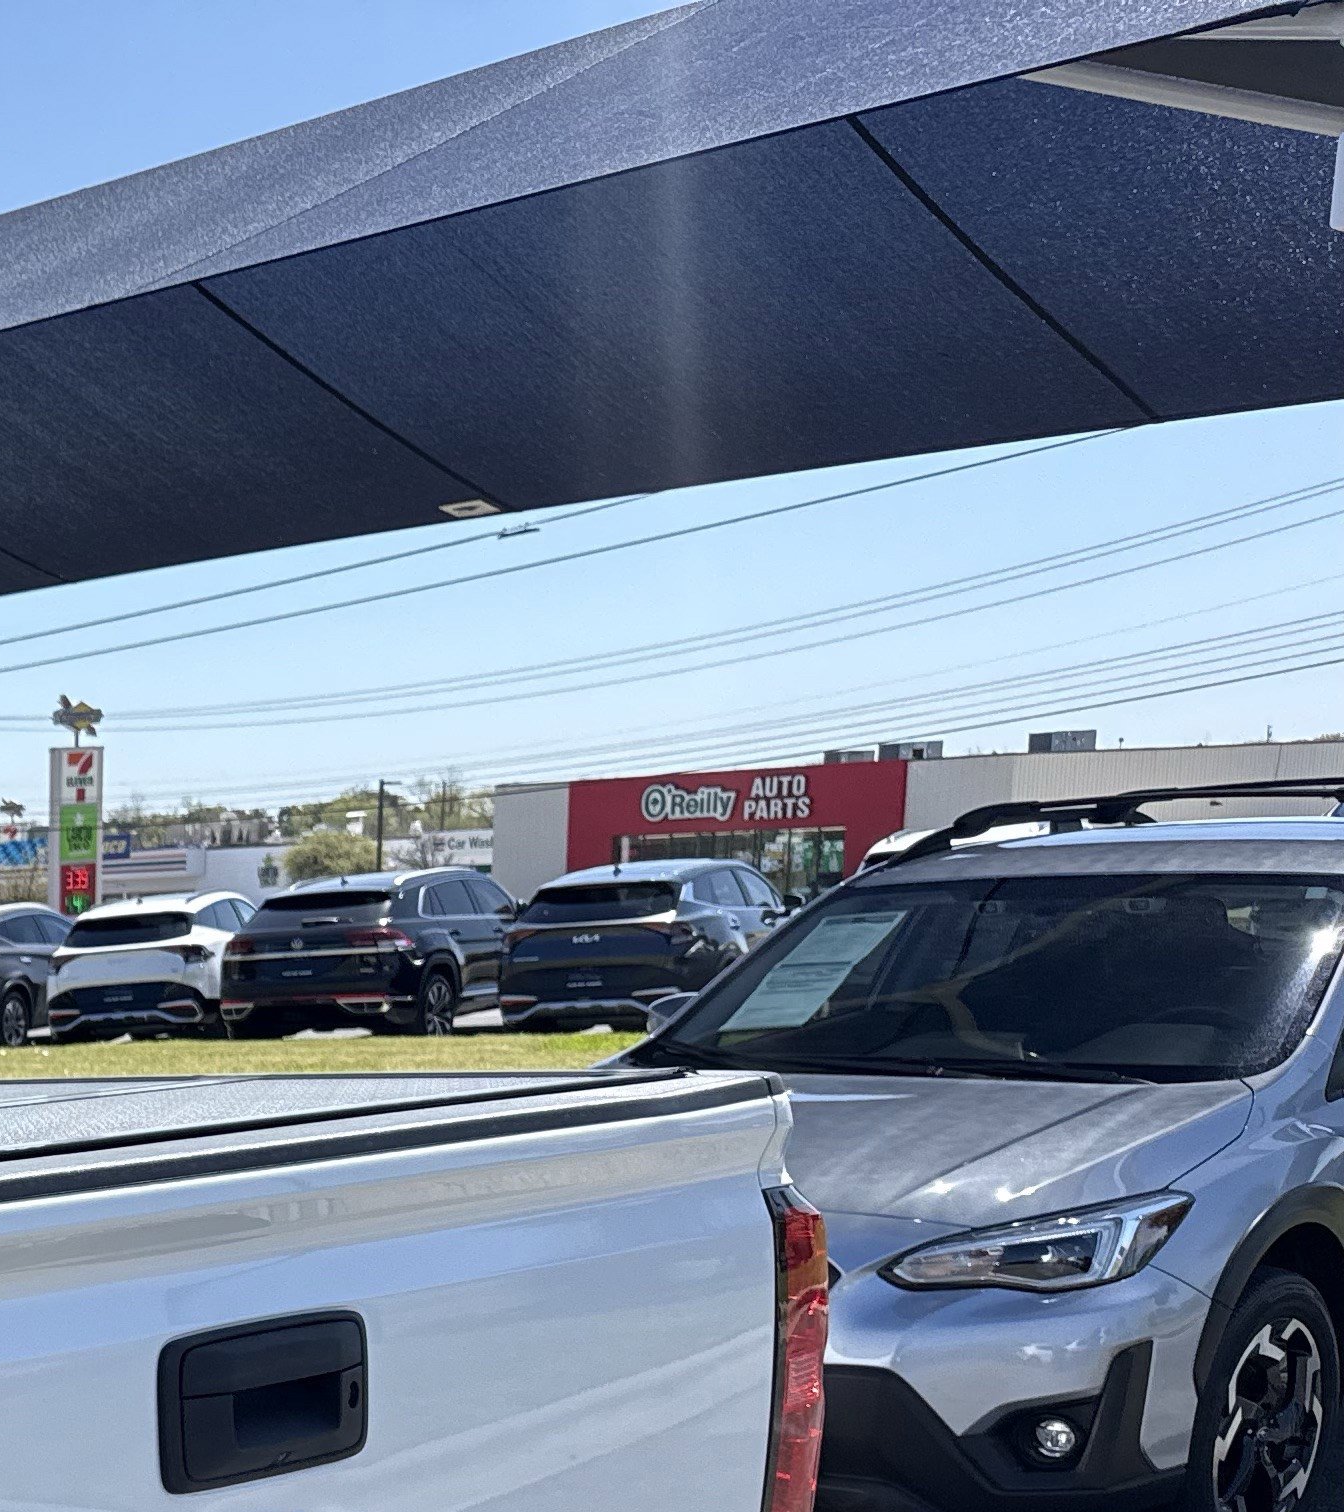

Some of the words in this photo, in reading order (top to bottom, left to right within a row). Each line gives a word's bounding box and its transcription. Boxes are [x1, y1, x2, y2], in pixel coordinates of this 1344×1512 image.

[750, 774, 806, 798] AUTO
[642, 783, 736, 822] O'Reilly
[742, 797, 811, 821] PARTS
